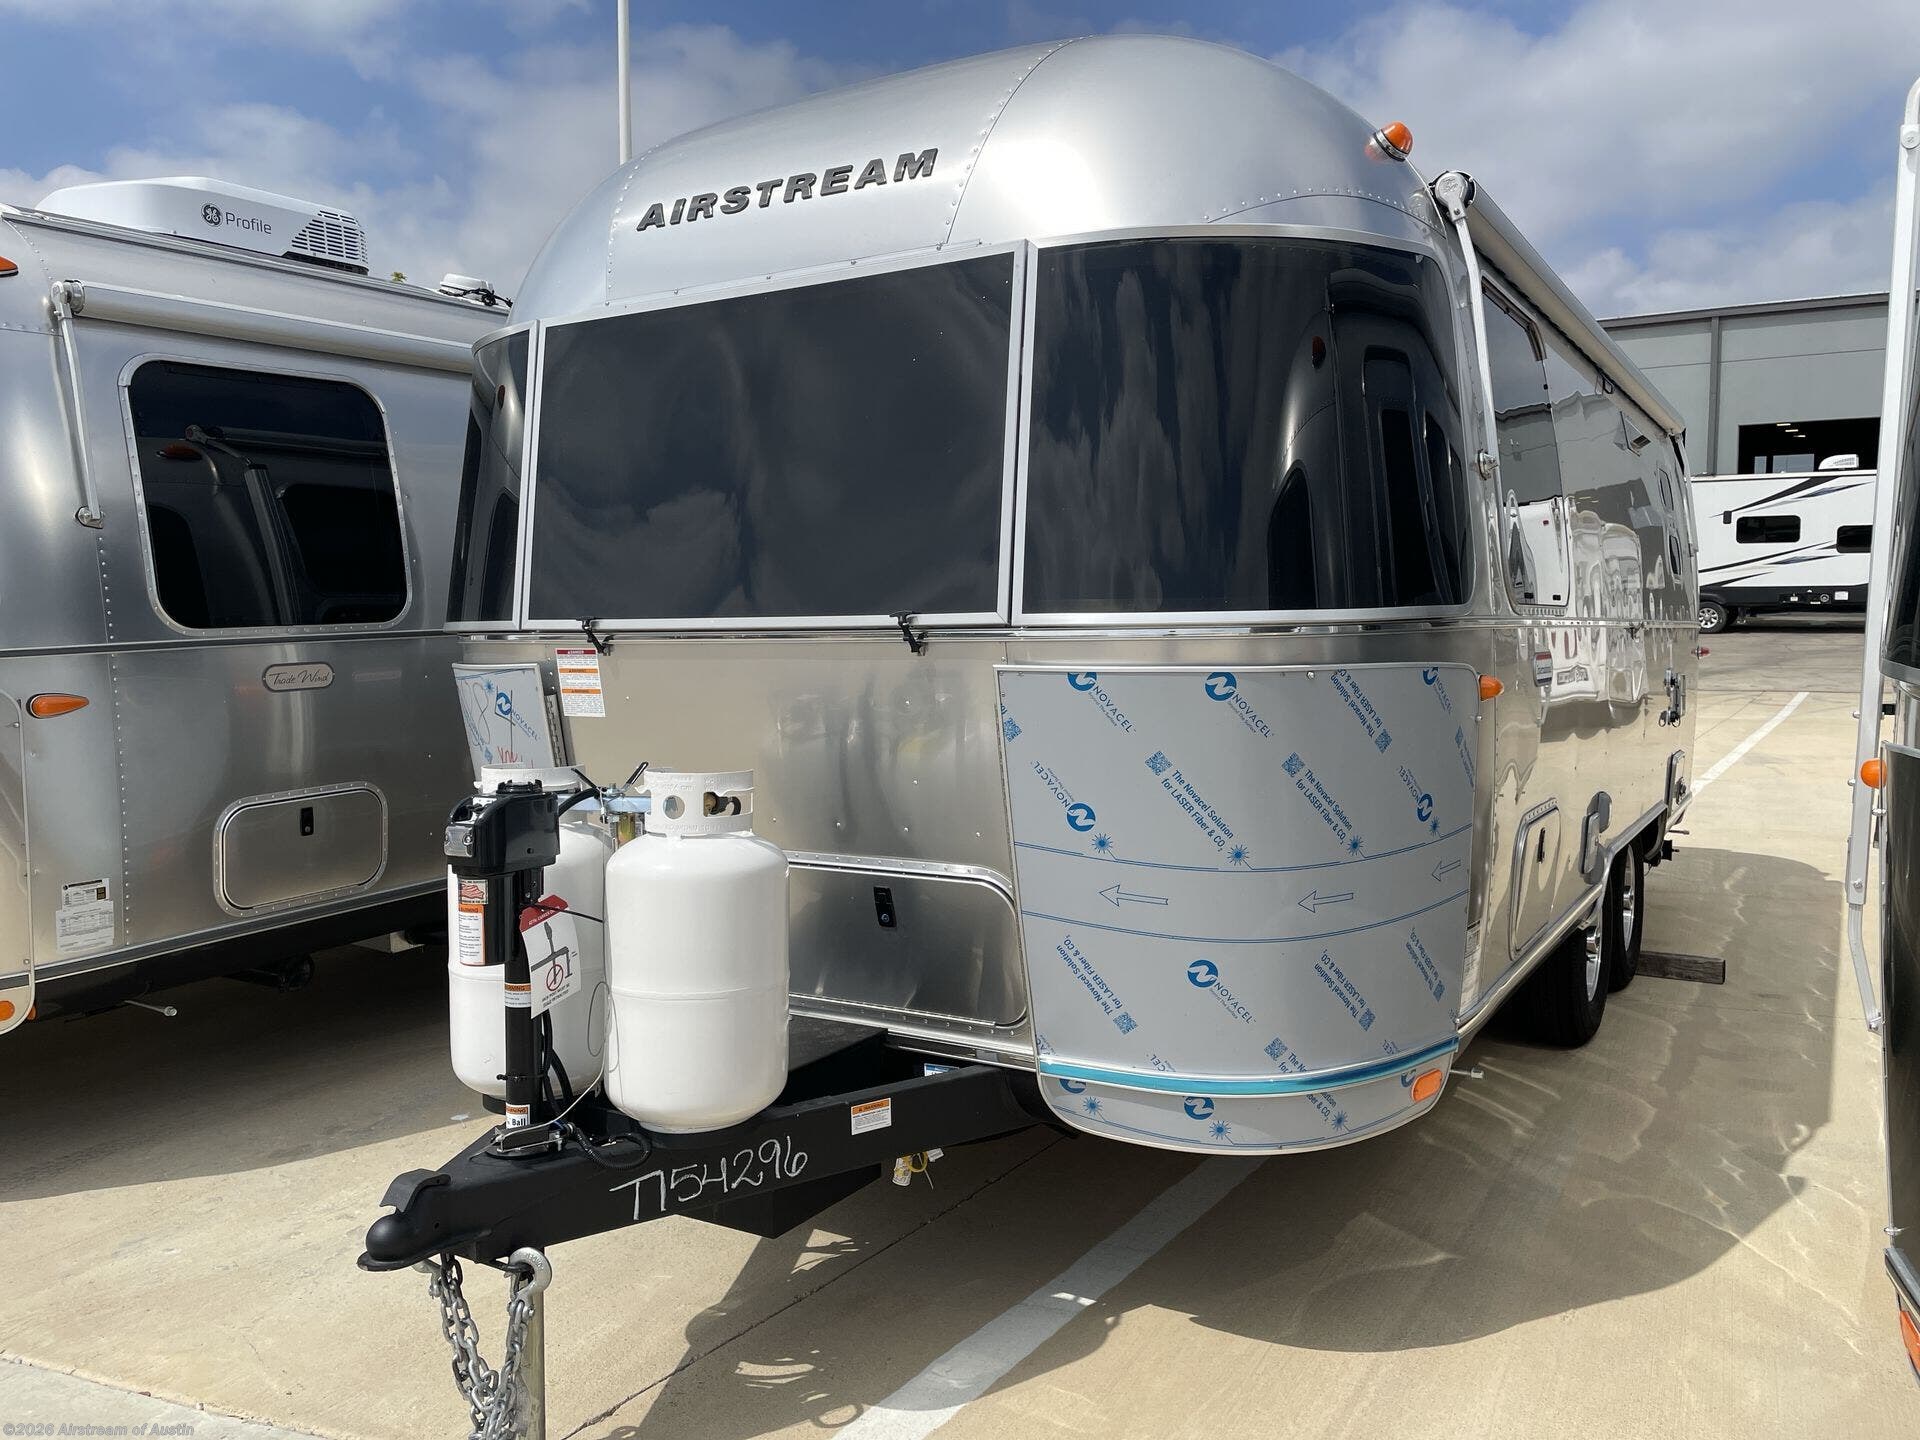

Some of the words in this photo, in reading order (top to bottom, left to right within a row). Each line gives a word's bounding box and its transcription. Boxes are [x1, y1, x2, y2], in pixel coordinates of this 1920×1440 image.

[636, 148, 938, 232] AIRSTREAM
[225, 212, 272, 234] Profile
[1093, 686, 1133, 732] NOVACEL
[1232, 694, 1271, 738] NOVACEL
[1034, 761, 1070, 808] NOVACEL
[1161, 778, 1173, 790] for
[1171, 789, 1195, 814] LASER
[1191, 811, 1210, 831] Fiber
[1207, 829, 1215, 837] &
[1172, 770, 1185, 785] The
[1183, 783, 1211, 812] Novacel
[1207, 810, 1234, 839] Solution
[1296, 779, 1306, 791] for
[1304, 788, 1323, 811] LASER
[1320, 808, 1335, 826] Fiber
[1332, 823, 1339, 832] &
[1304, 769, 1315, 784] The
[1314, 781, 1336, 807] Novacel
[1332, 804, 1353, 831] Solution
[1056, 945, 1080, 974] Solution
[1073, 949, 1080, 957] &
[1078, 956, 1095, 975] Fiber
[1077, 973, 1102, 1002] Novacel
[1092, 974, 1114, 998] LASER
[1101, 1001, 1113, 1015] The
[1112, 998, 1123, 1009] for
[1214, 982, 1252, 1024] NOVACEL
[1279, 1062, 1288, 1073] for
[1288, 1052, 1298, 1066] The
[511, 1118, 526, 1127] Ball
